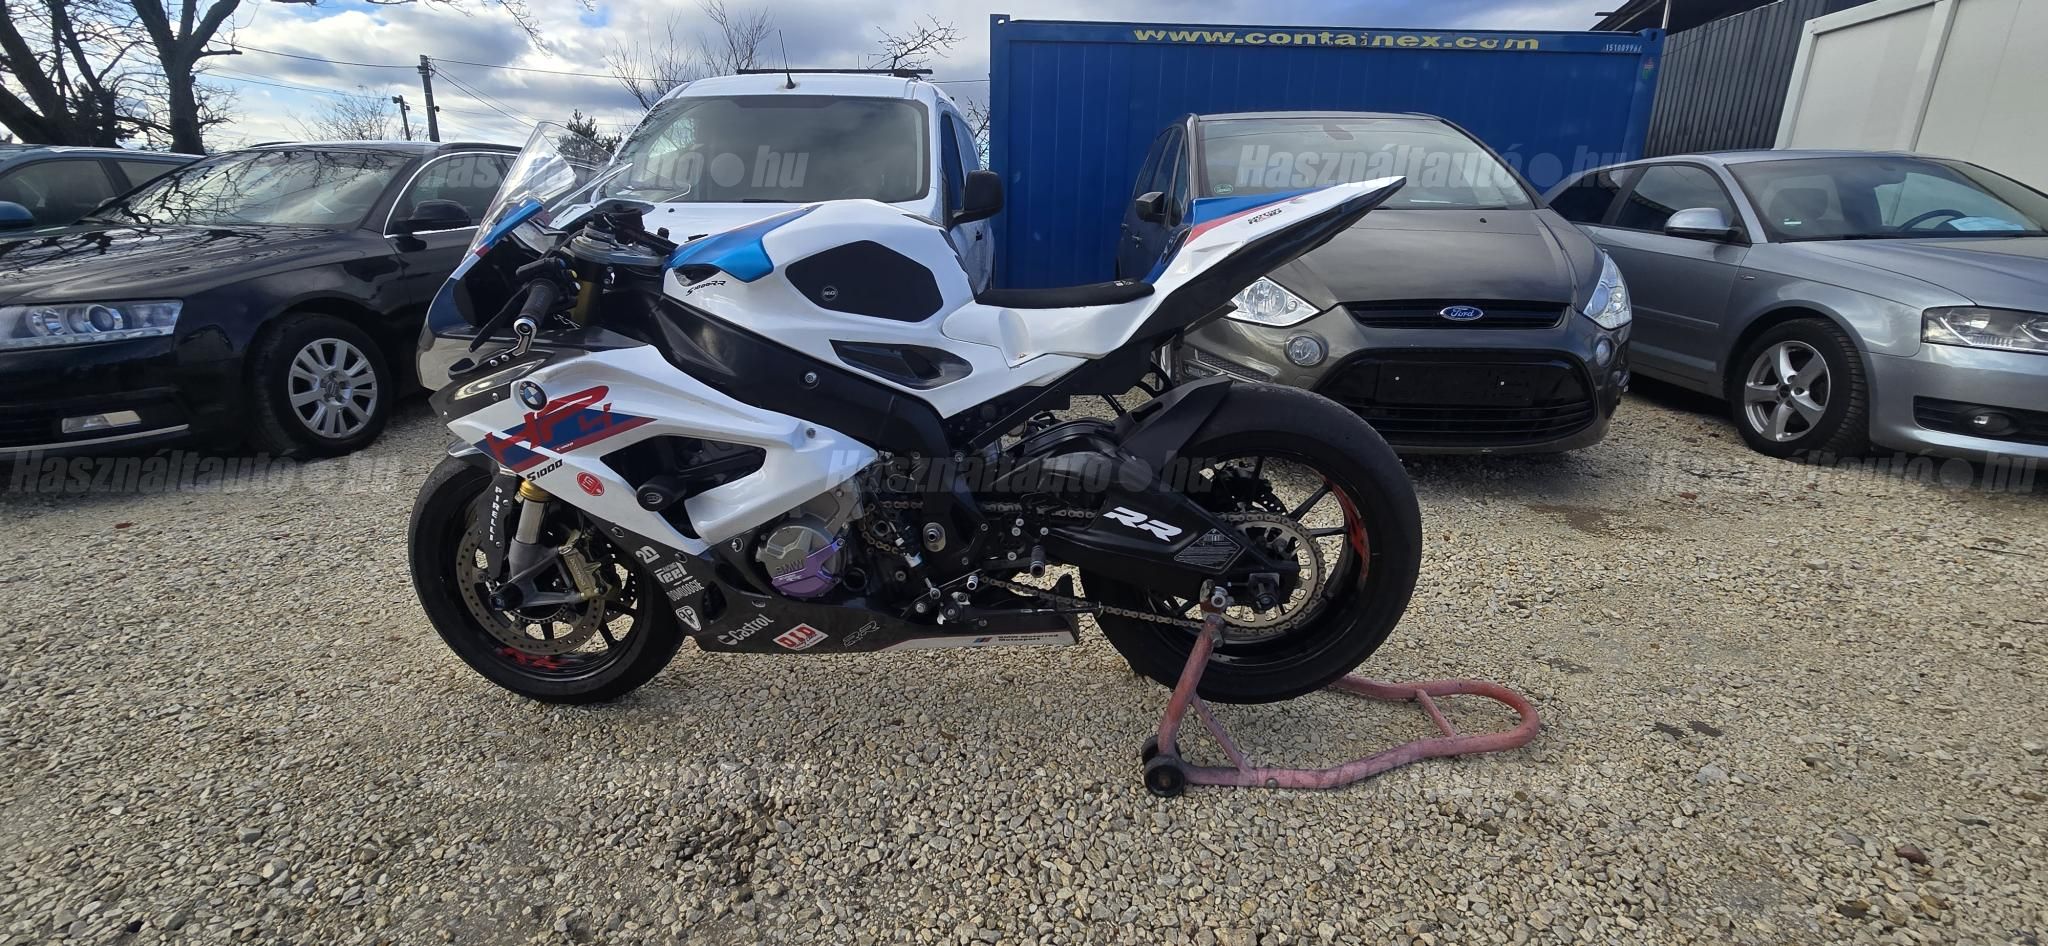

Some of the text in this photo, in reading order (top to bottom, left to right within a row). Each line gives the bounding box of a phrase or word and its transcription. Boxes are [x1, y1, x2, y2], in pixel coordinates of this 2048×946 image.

[1133, 29, 1539, 50] www.containex.com
[526, 459, 563, 482] S1000
[489, 486, 503, 541] PIRELLI
[1103, 506, 1182, 542] RR
[728, 613, 775, 641] Castrol
